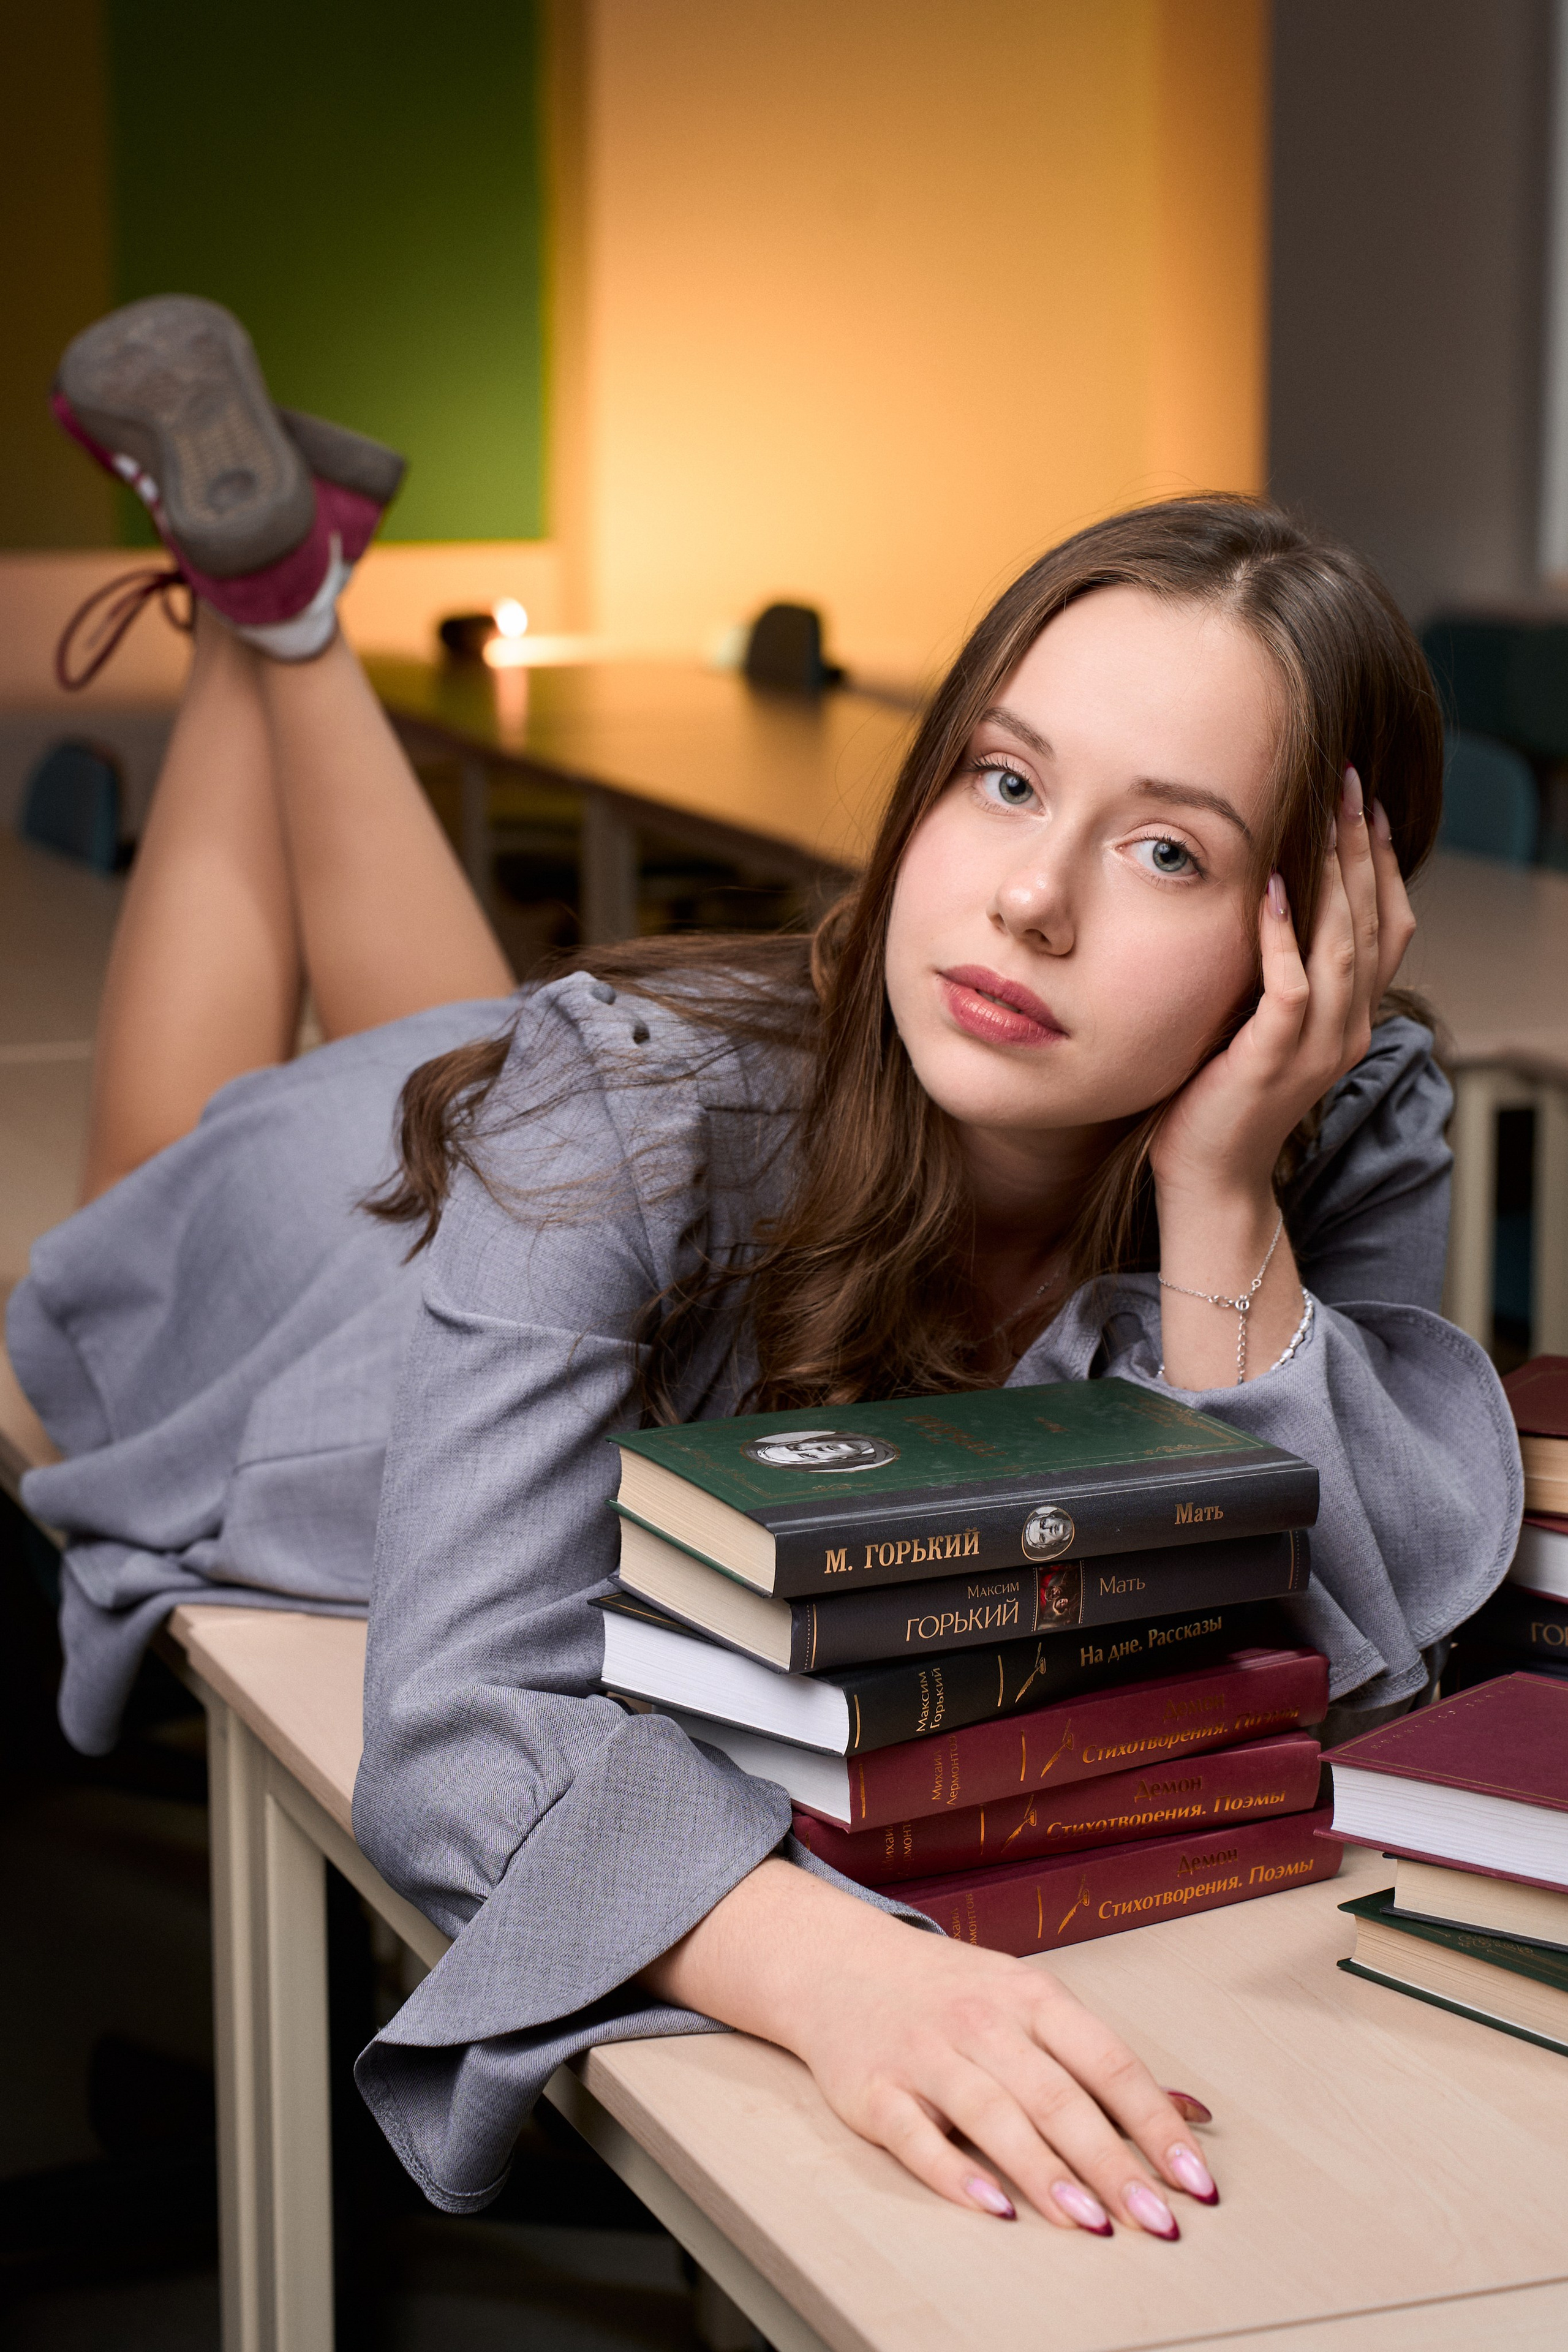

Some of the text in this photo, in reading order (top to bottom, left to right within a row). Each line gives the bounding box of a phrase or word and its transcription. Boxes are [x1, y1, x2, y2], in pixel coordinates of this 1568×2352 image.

[1175, 1502, 1224, 1525] Мать
[824, 1528, 980, 1574] М. ГОРЬКИЙ
[1099, 1576, 1145, 1596] Мать
[906, 1598, 1019, 1641] ГОРЬКИЙ
[1080, 1616, 1223, 1667] На дне. Рассказы
[1532, 1622, 1568, 1646] ГО
[916, 1671, 930, 1732] Максим
[930, 1667, 946, 1729] Горький
[1163, 1693, 1225, 1724] Демон
[1082, 1706, 1300, 1763] Стихотворения. Поэмы
[931, 1749, 943, 1800] Михаил
[946, 1735, 961, 1806] Лермонтов
[1134, 1776, 1202, 1803] Демон
[1046, 1790, 1286, 1839] Стихотворения. Поэмы
[1177, 1848, 1238, 1877] Демон
[1098, 1859, 1314, 1920] Стихотворения. Поэмы
